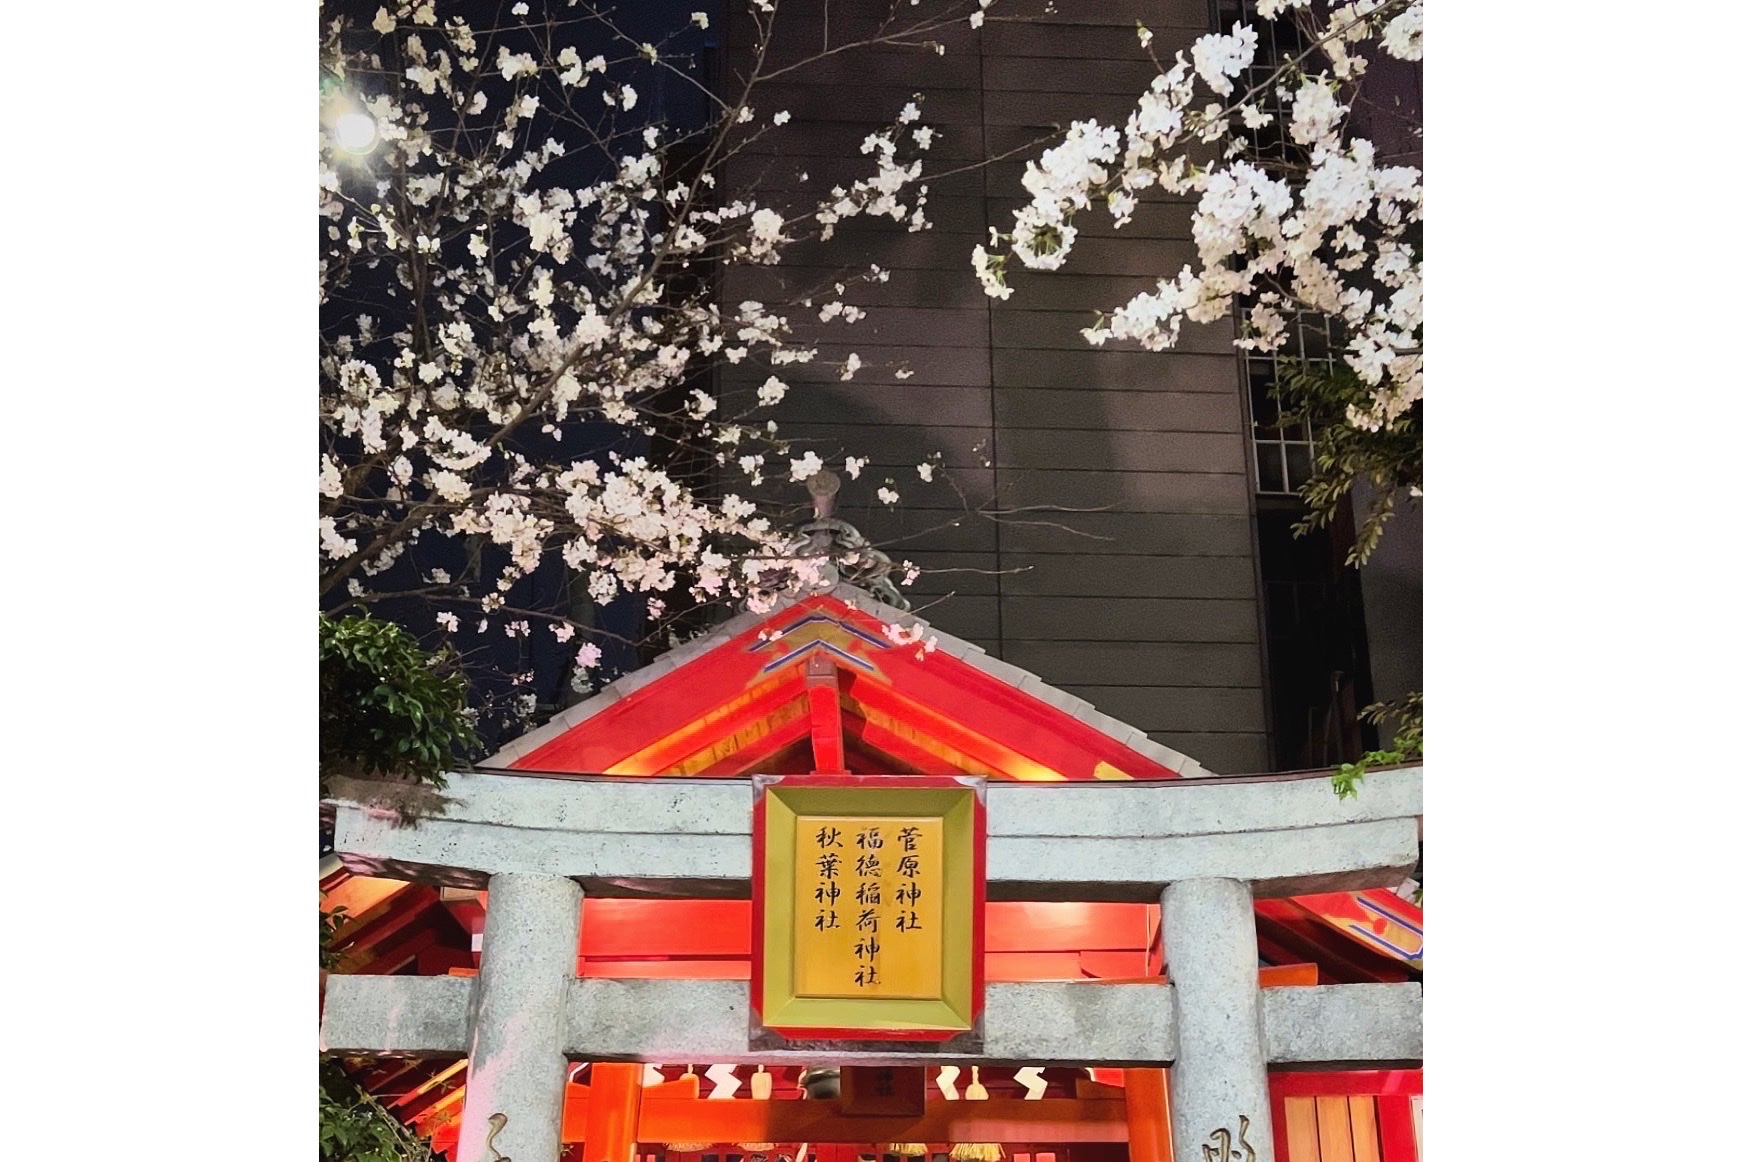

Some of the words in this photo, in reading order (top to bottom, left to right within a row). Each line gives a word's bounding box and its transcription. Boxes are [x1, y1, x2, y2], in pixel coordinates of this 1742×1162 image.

[814, 825, 844, 932] 秋葉神社
[896, 826, 923, 933] 菅原神社
